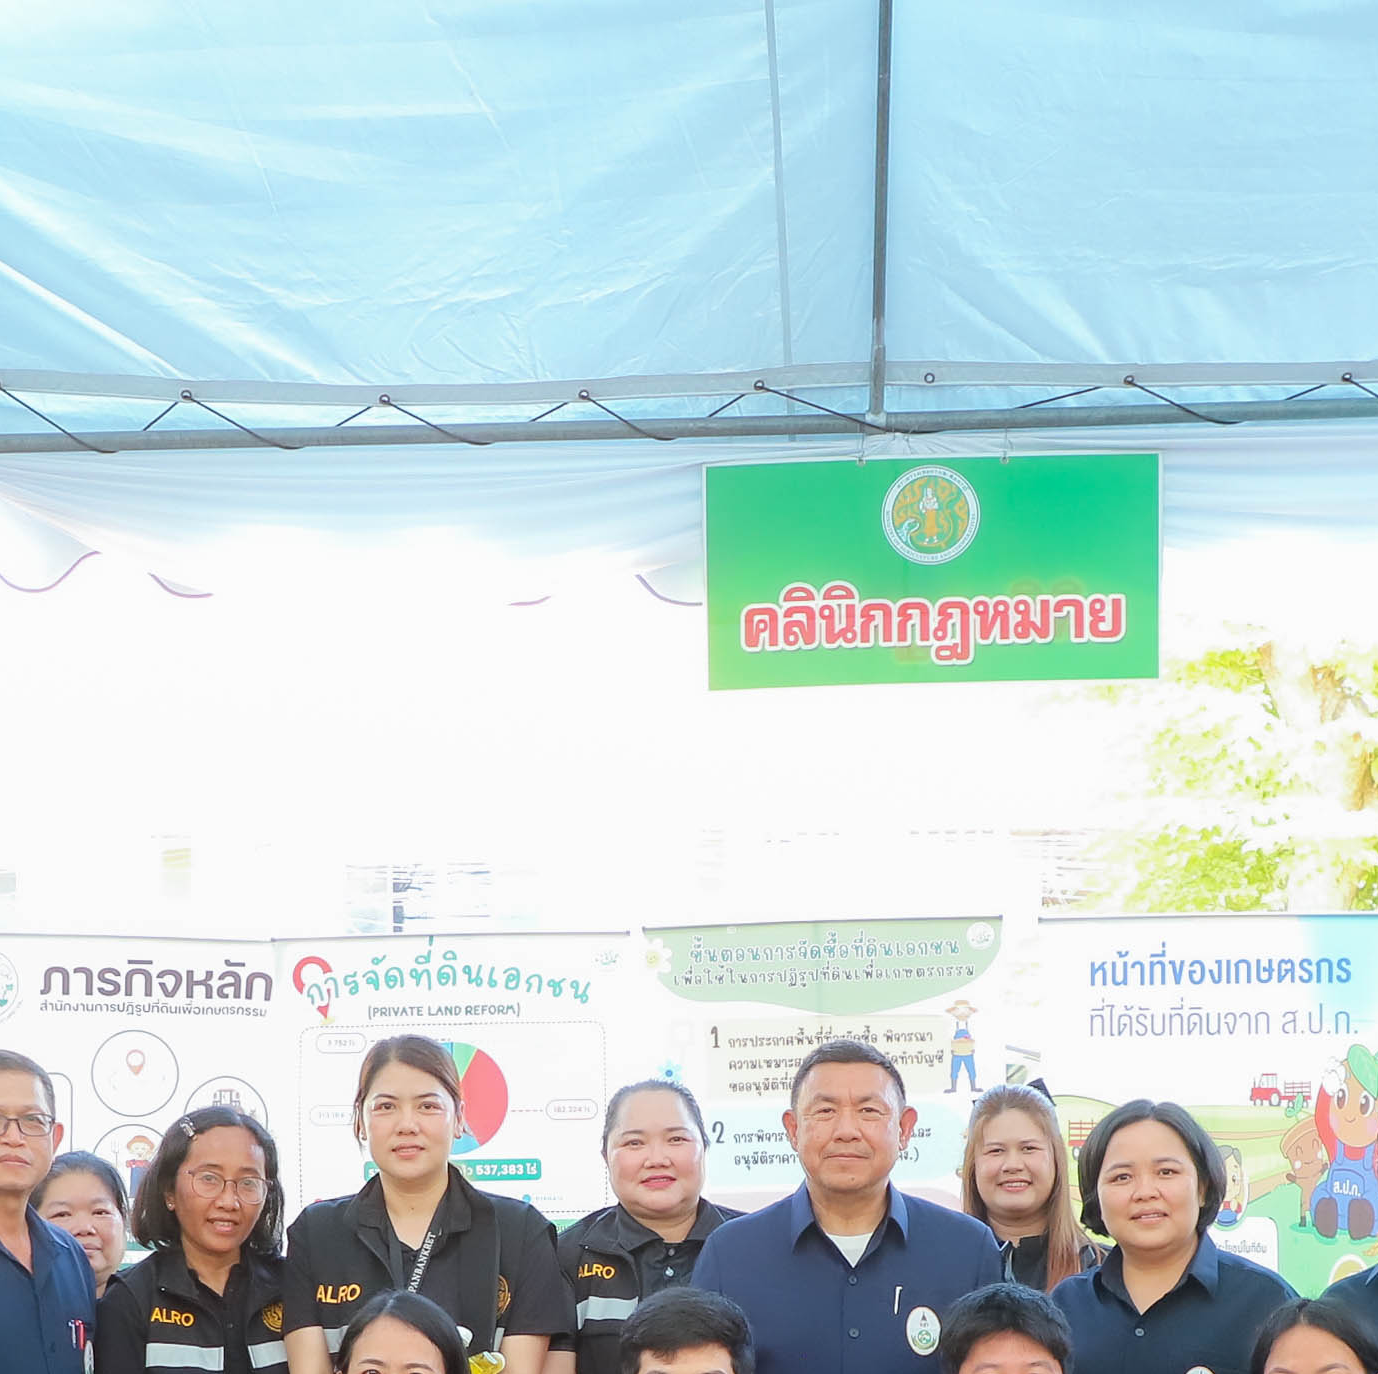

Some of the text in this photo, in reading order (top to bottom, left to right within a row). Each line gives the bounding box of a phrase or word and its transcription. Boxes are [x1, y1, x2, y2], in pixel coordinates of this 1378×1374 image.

[743, 584, 1123, 662] คลินิกกฎหมาย
[306, 936, 591, 1005] การจัดที่ดินเอกชน
[1090, 941, 1353, 987] หน้าที่ของเกษตรกร
[39, 959, 273, 1002] ภารกิจหลัก
[367, 1002, 521, 1020] (PRIVATE LAND REFORM)
[1089, 997, 1359, 1037] ที่ได้รับที่ดินจาก ส.ป.ก.
[711, 1026, 721, 1048] 1
[712, 1121, 725, 1144] 2
[316, 1284, 361, 1304] ALRO
[150, 1307, 195, 1327] ALRO
